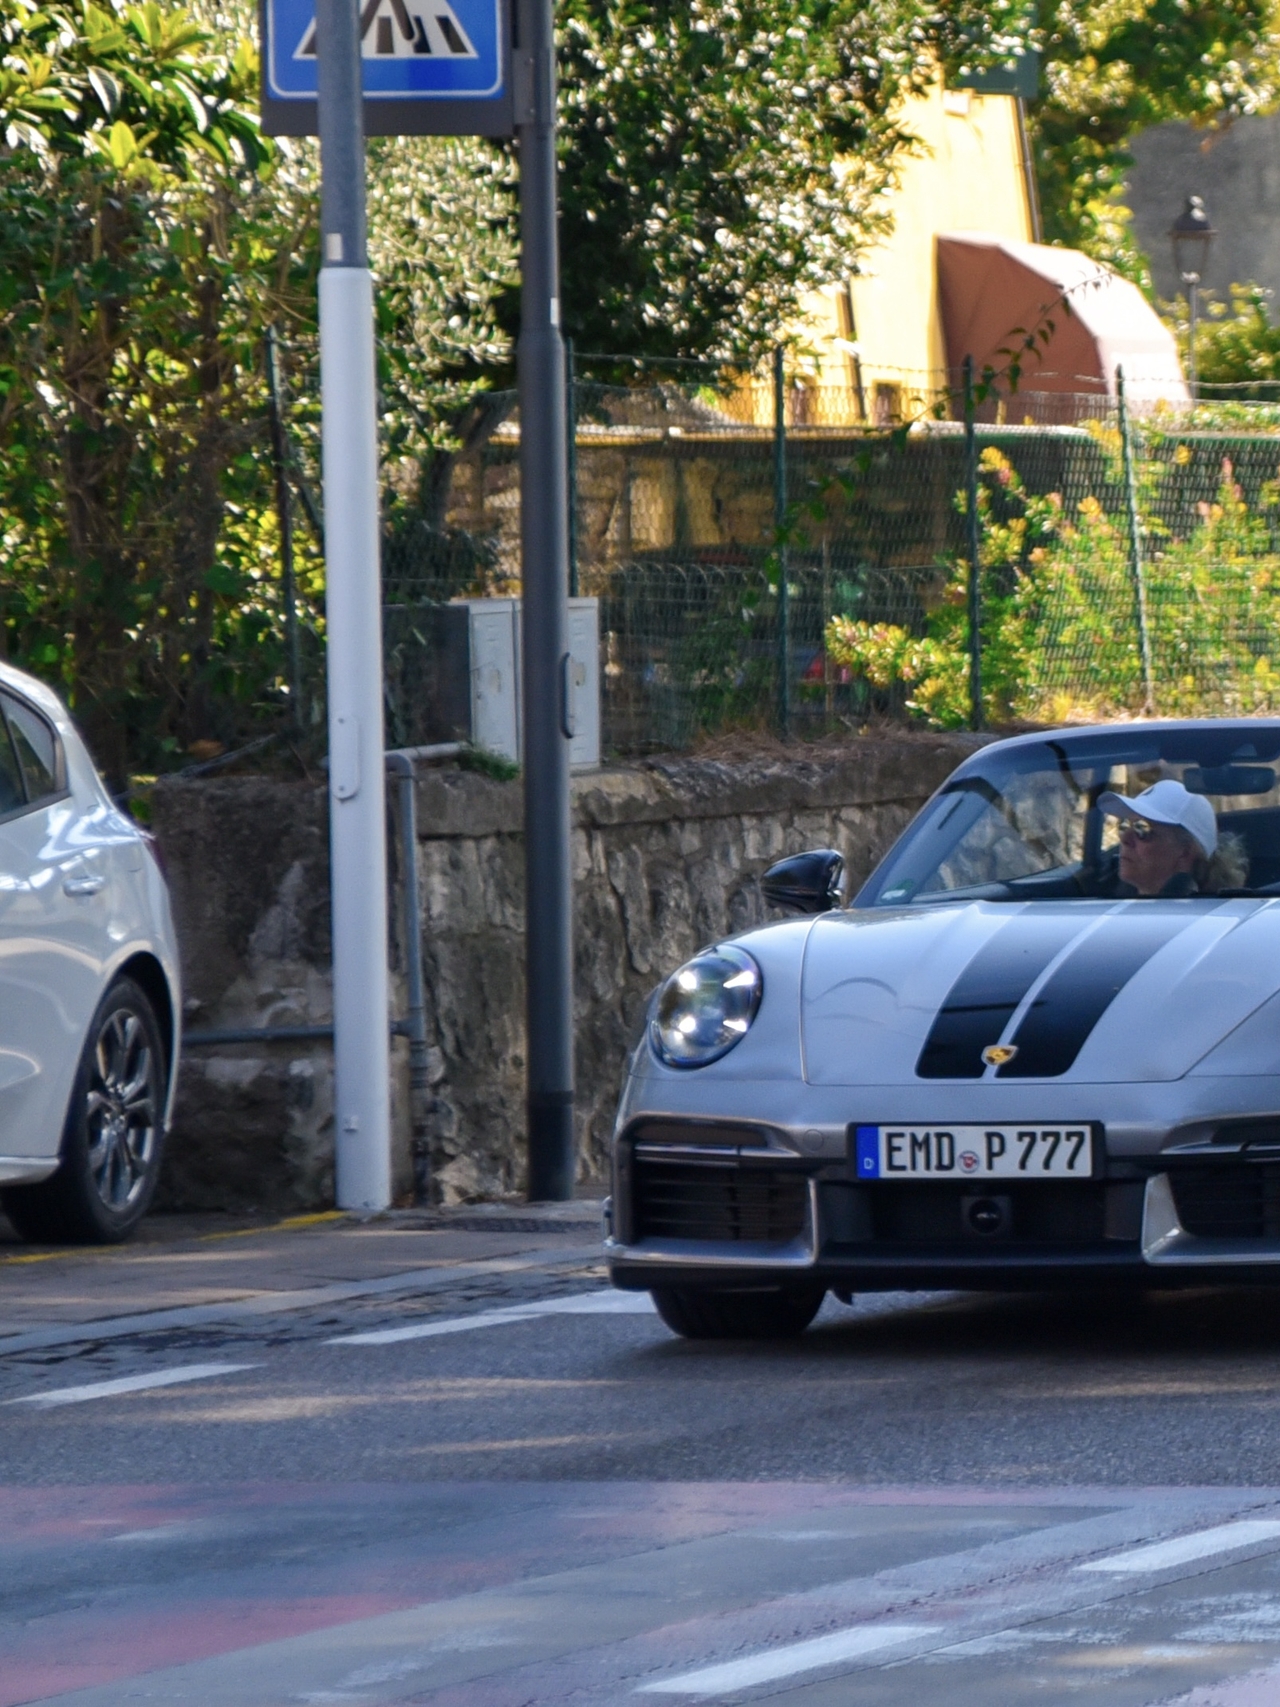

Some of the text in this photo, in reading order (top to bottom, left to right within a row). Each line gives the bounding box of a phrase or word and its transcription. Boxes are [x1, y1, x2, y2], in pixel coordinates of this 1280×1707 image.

[886, 1131, 1086, 1171] EMD P 777
